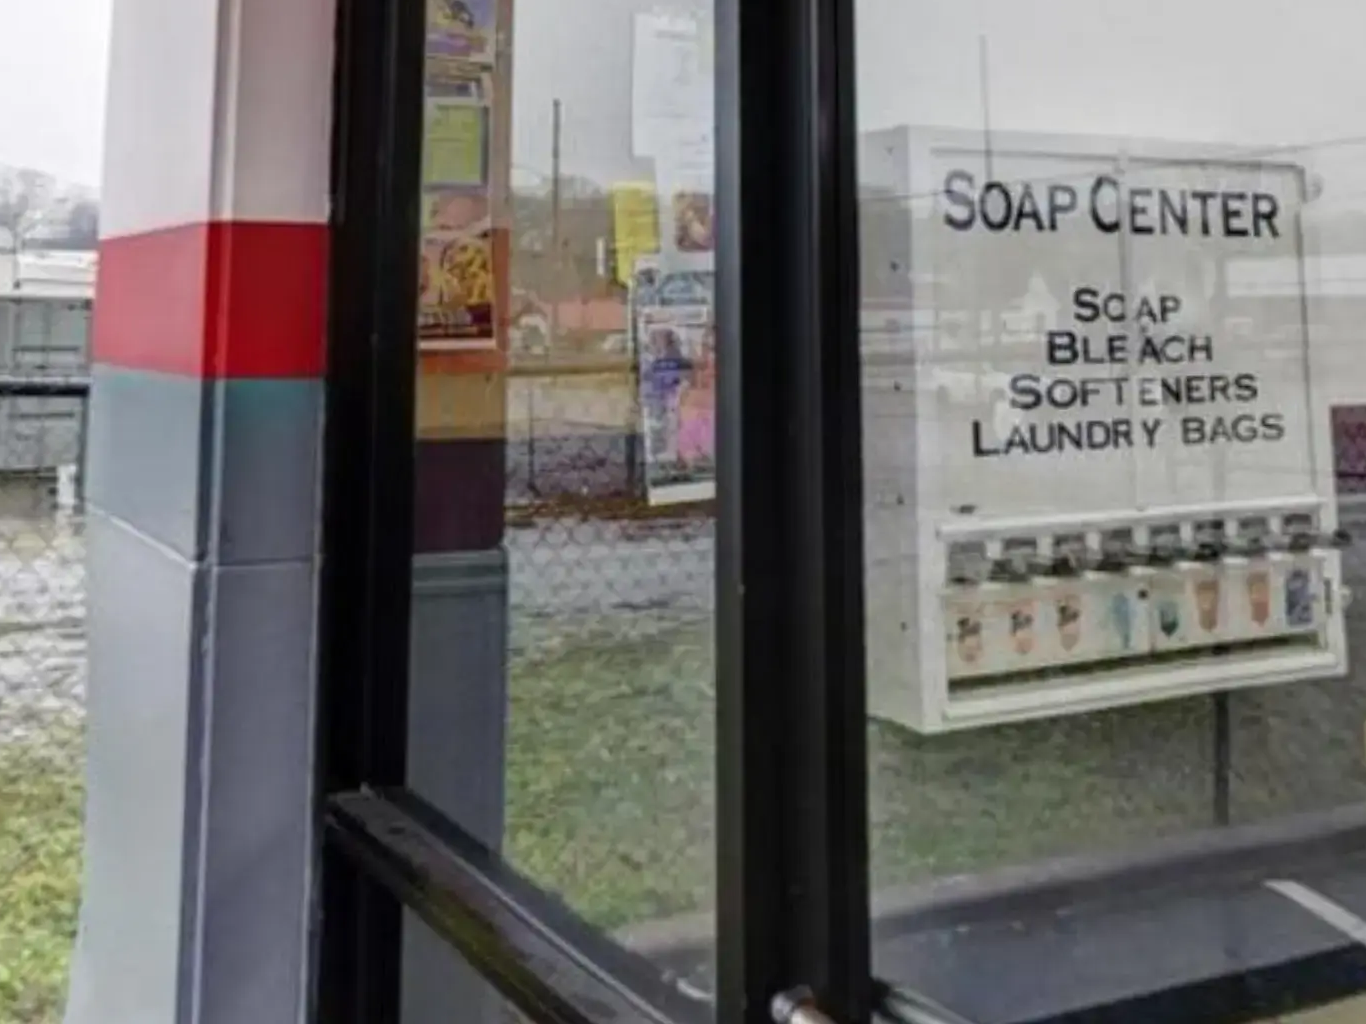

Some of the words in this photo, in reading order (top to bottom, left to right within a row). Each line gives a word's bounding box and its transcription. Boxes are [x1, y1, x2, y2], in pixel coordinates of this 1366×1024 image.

[943, 169, 1078, 232] SOAP
[1090, 175, 1281, 238] CENTER
[1072, 287, 1182, 324] SOAP
[1046, 330, 1214, 366] BLEACH
[1008, 373, 1259, 411] SOFTENERS
[971, 417, 1163, 458] LAUNDRY
[1180, 413, 1286, 446] BAGS
